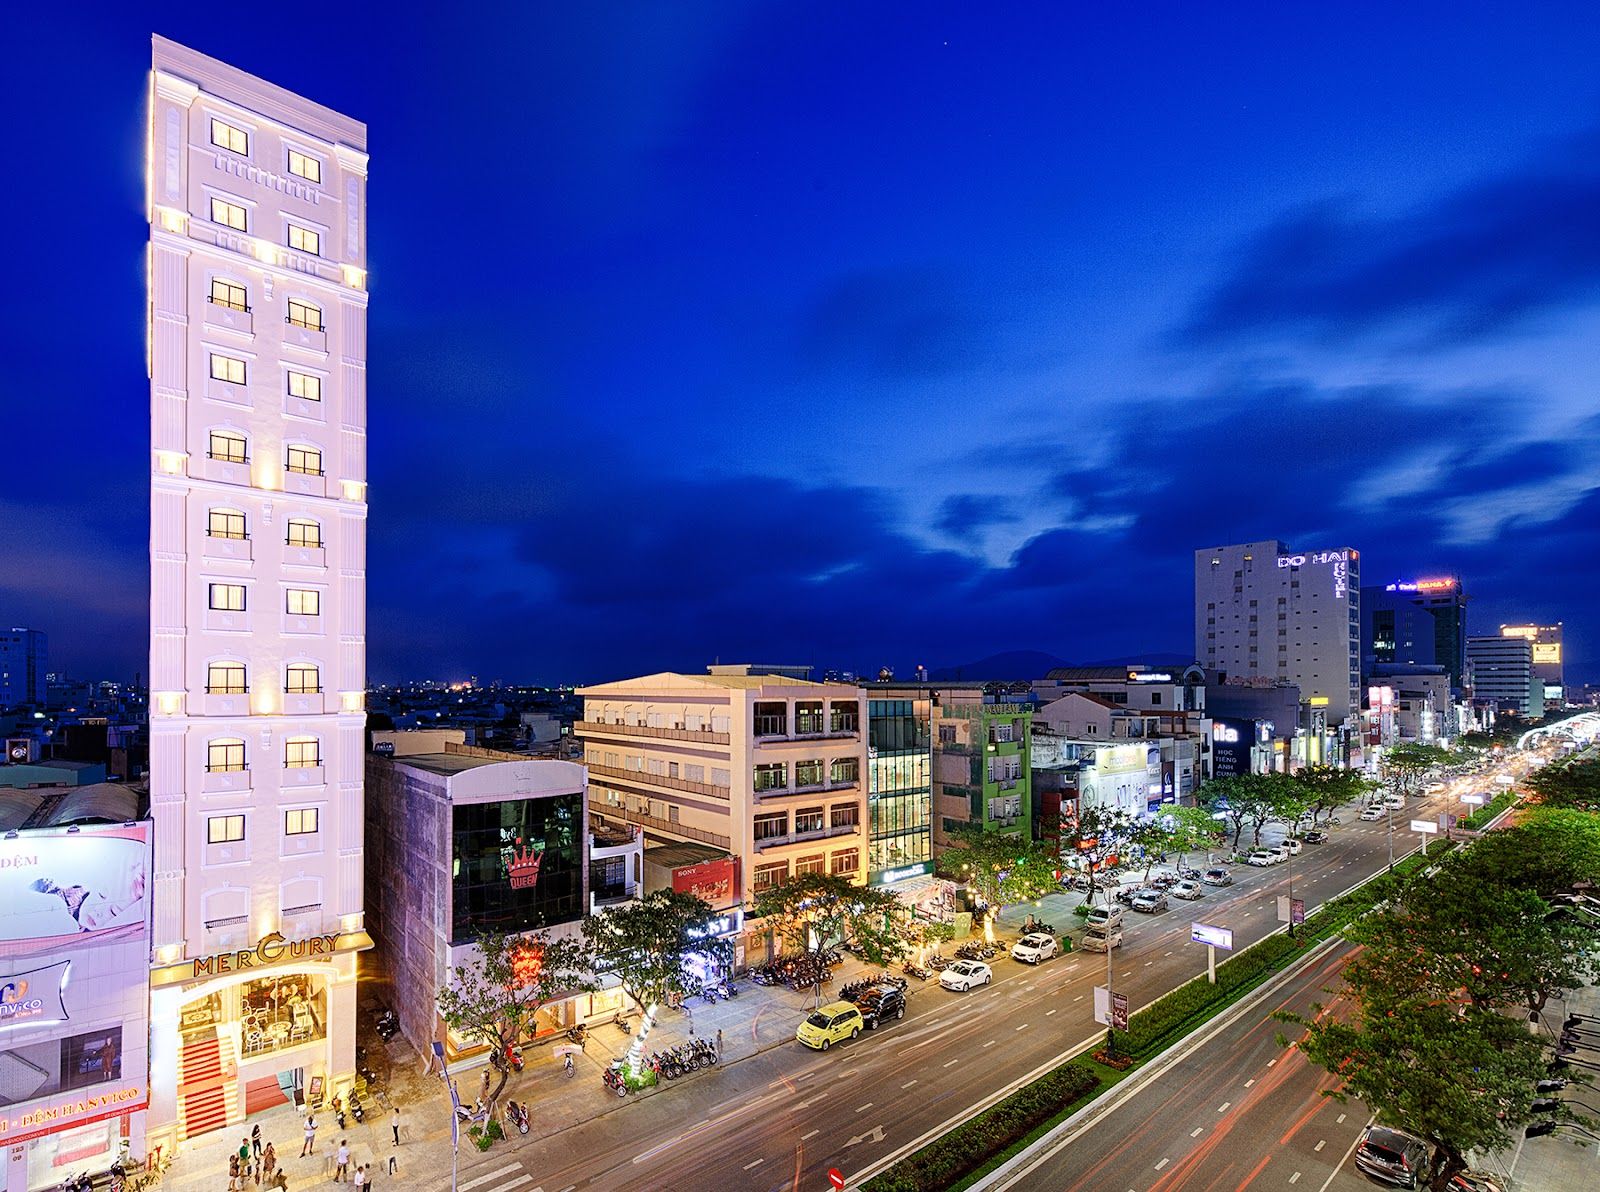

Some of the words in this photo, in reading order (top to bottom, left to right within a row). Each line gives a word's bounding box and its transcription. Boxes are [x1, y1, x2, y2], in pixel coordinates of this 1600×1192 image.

[1213, 722, 1238, 741] ila
[510, 875, 537, 889] QUEEN
[677, 868, 697, 877] SONY
[193, 930, 341, 978] MERCURY
[61, 1087, 140, 1118] HANVICO
